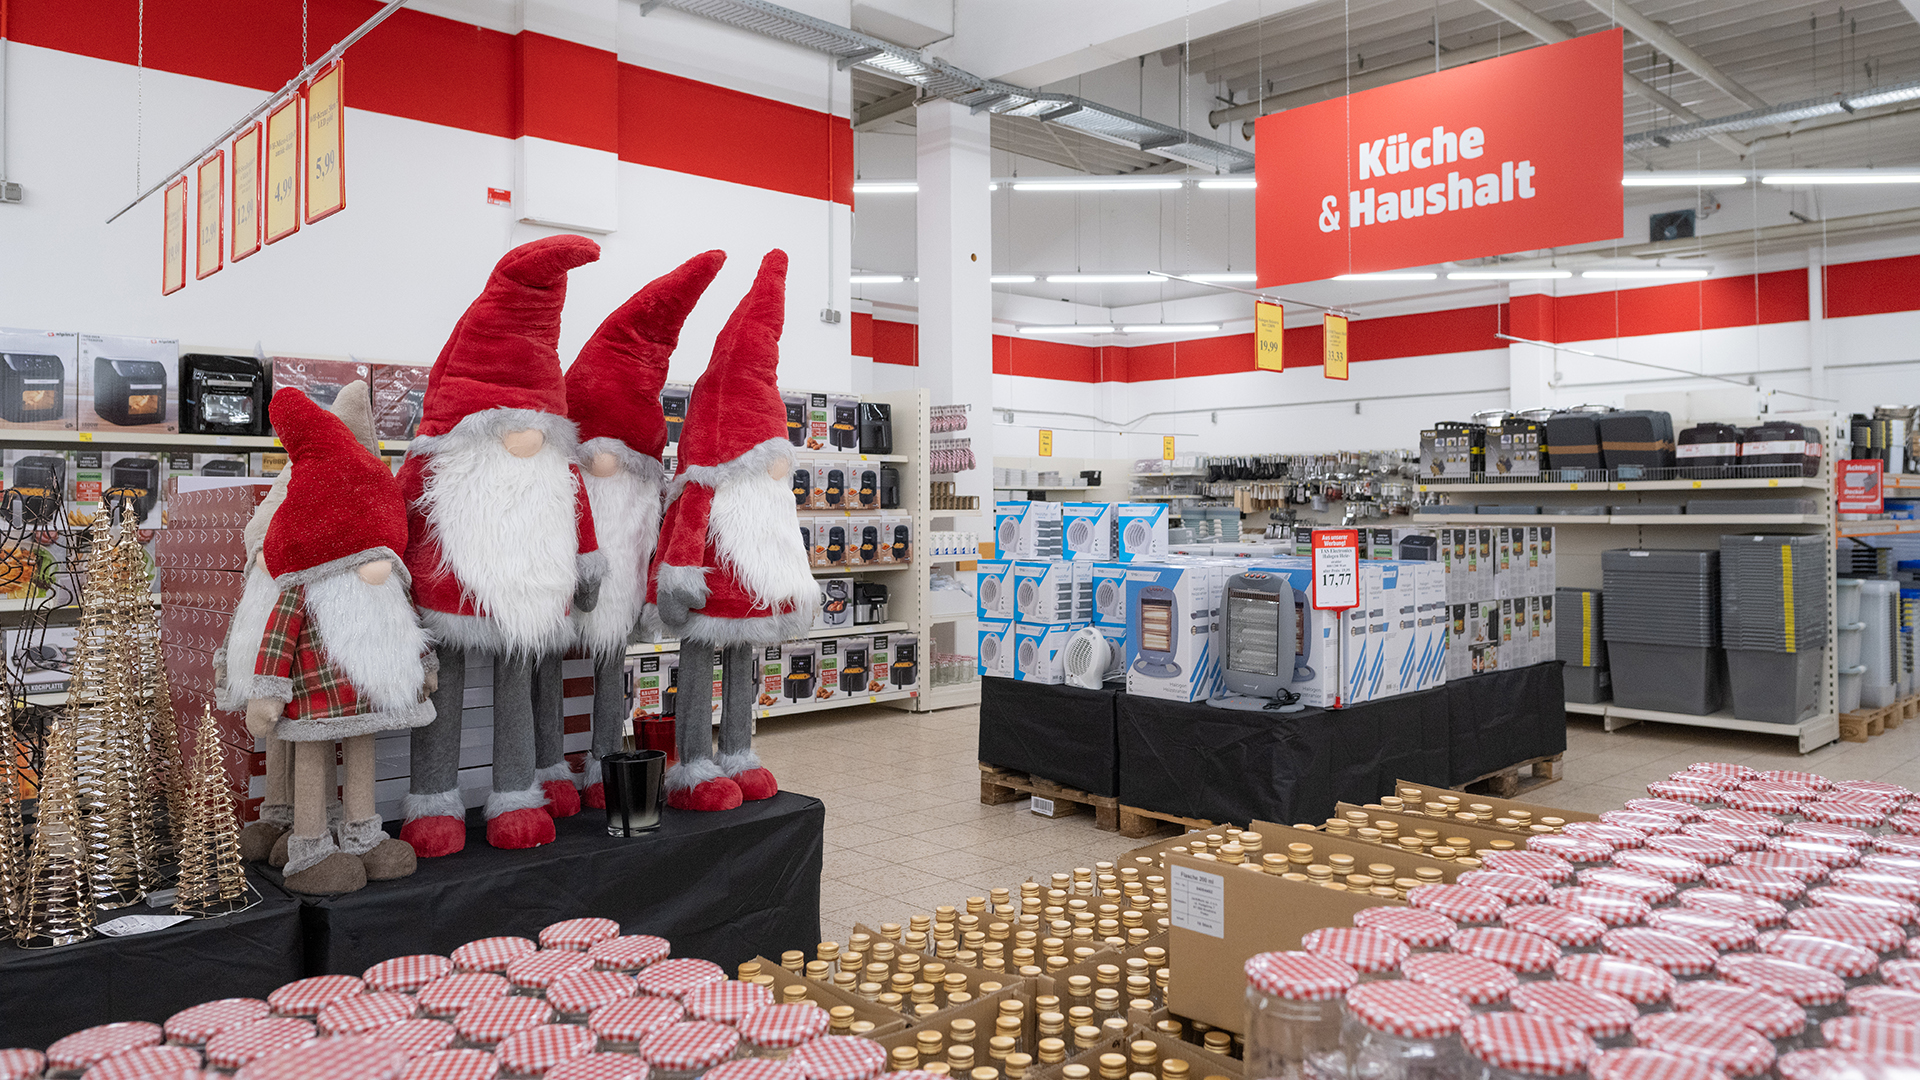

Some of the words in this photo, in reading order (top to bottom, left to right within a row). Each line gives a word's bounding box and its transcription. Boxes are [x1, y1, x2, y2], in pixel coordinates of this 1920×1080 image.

[1359, 125, 1484, 180] Küche
[316, 150, 335, 181] 5,99
[274, 176, 293, 206] 4,99
[1318, 195, 1341, 233] &
[1350, 160, 1536, 228] Haushalt
[1260, 339, 1279, 354] 19,99
[1323, 573, 1352, 588] 17,77
[31, 682, 64, 691] KOCHPLATTE
[1180, 871, 1198, 880] Flasche
